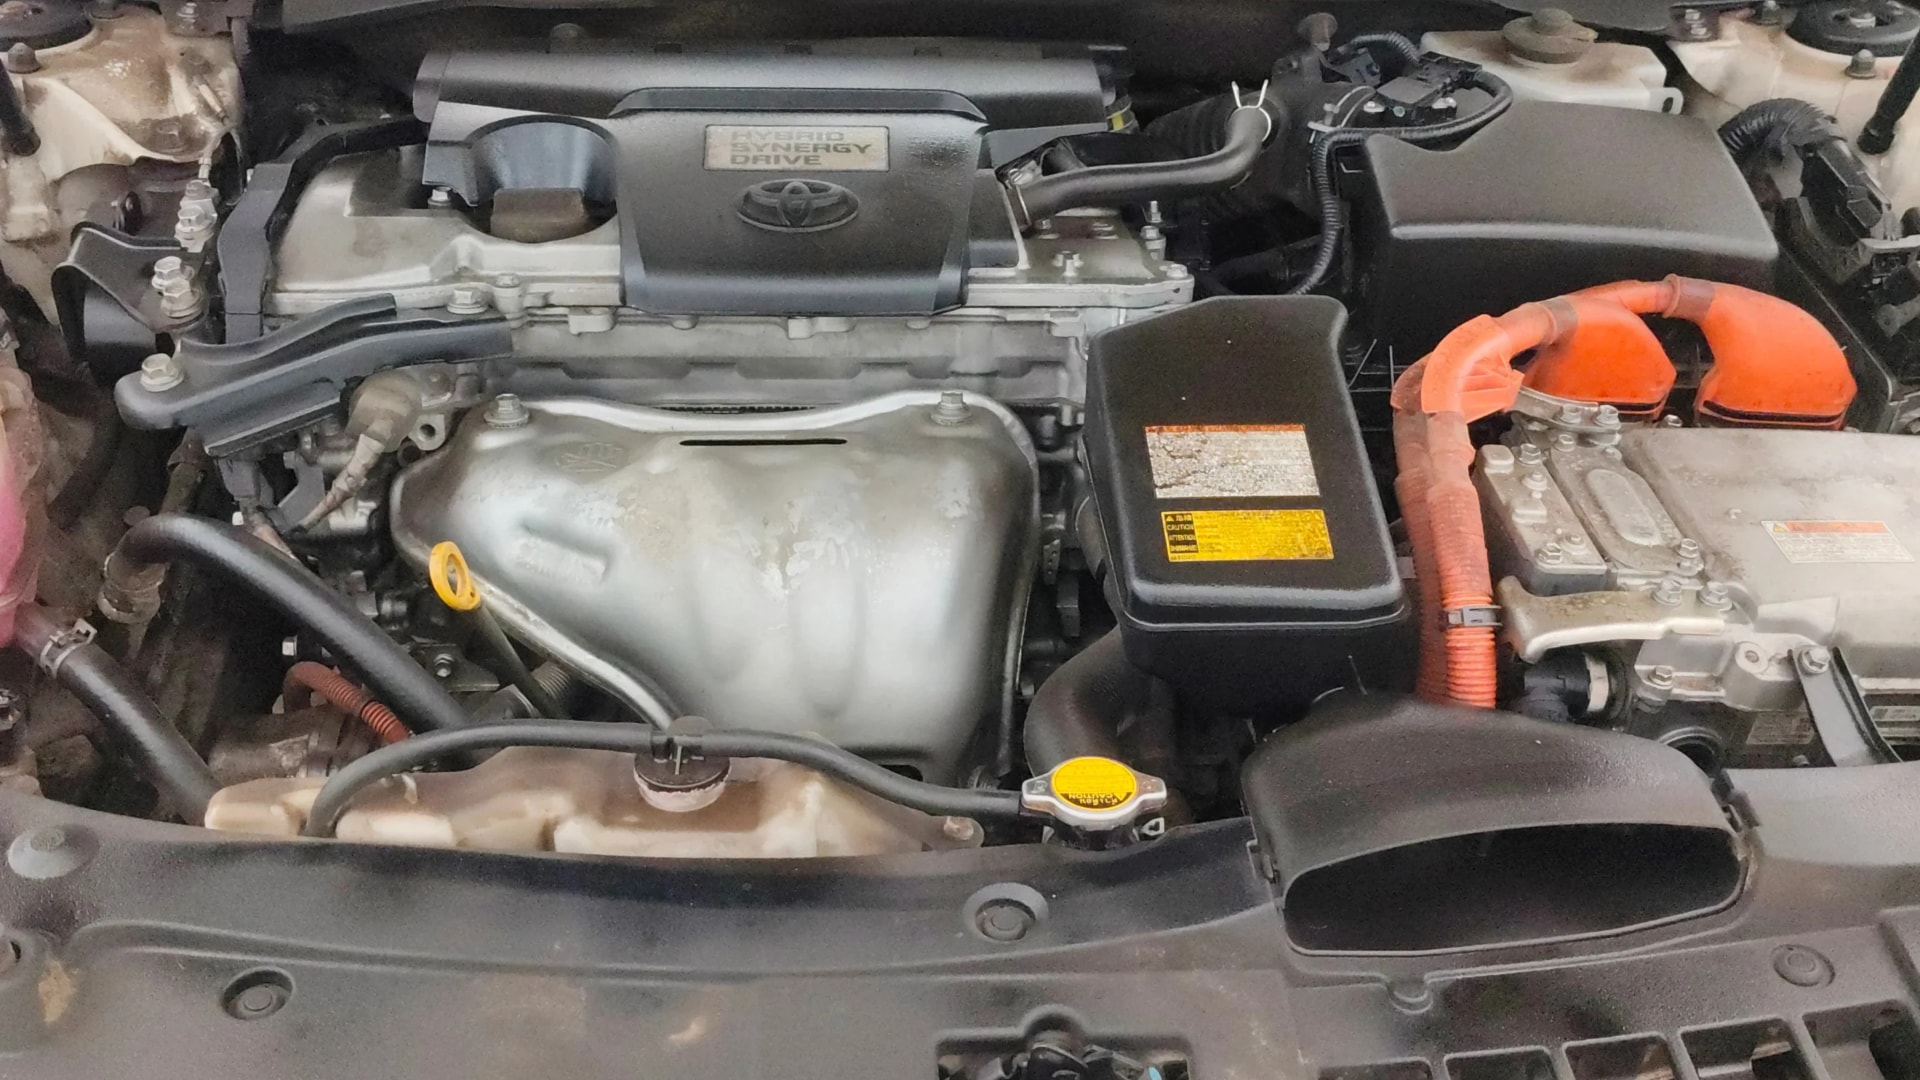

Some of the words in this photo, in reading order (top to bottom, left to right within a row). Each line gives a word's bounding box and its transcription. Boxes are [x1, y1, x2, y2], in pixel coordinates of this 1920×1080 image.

[731, 131, 844, 142] HYBRID
[730, 143, 872, 154] SYNERGY
[730, 154, 822, 165] DRIVE
[1167, 523, 1194, 531] CAUTION
